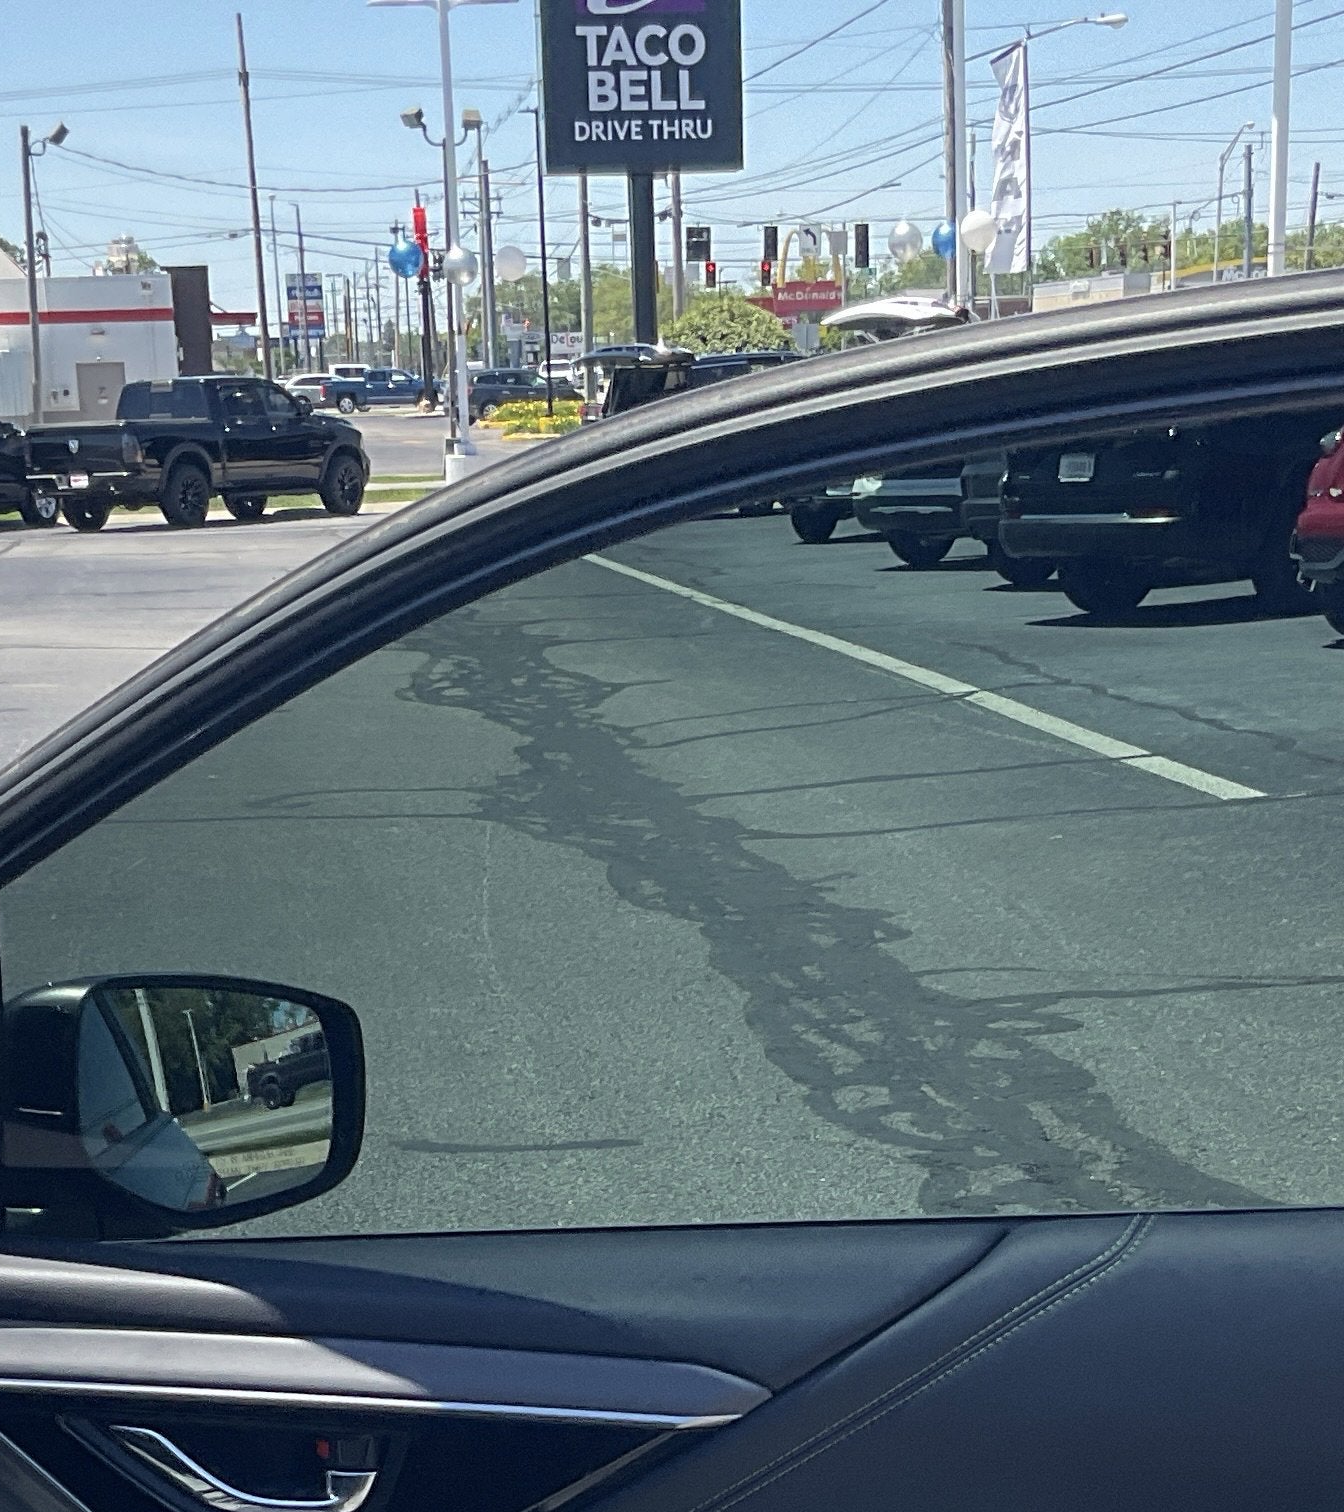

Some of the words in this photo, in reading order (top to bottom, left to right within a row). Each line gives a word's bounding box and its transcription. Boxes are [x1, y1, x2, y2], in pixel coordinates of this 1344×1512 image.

[575, 24, 706, 66] TACO
[587, 69, 706, 112] BELL
[574, 120, 643, 142] DRIVE
[648, 118, 713, 140] THRU
